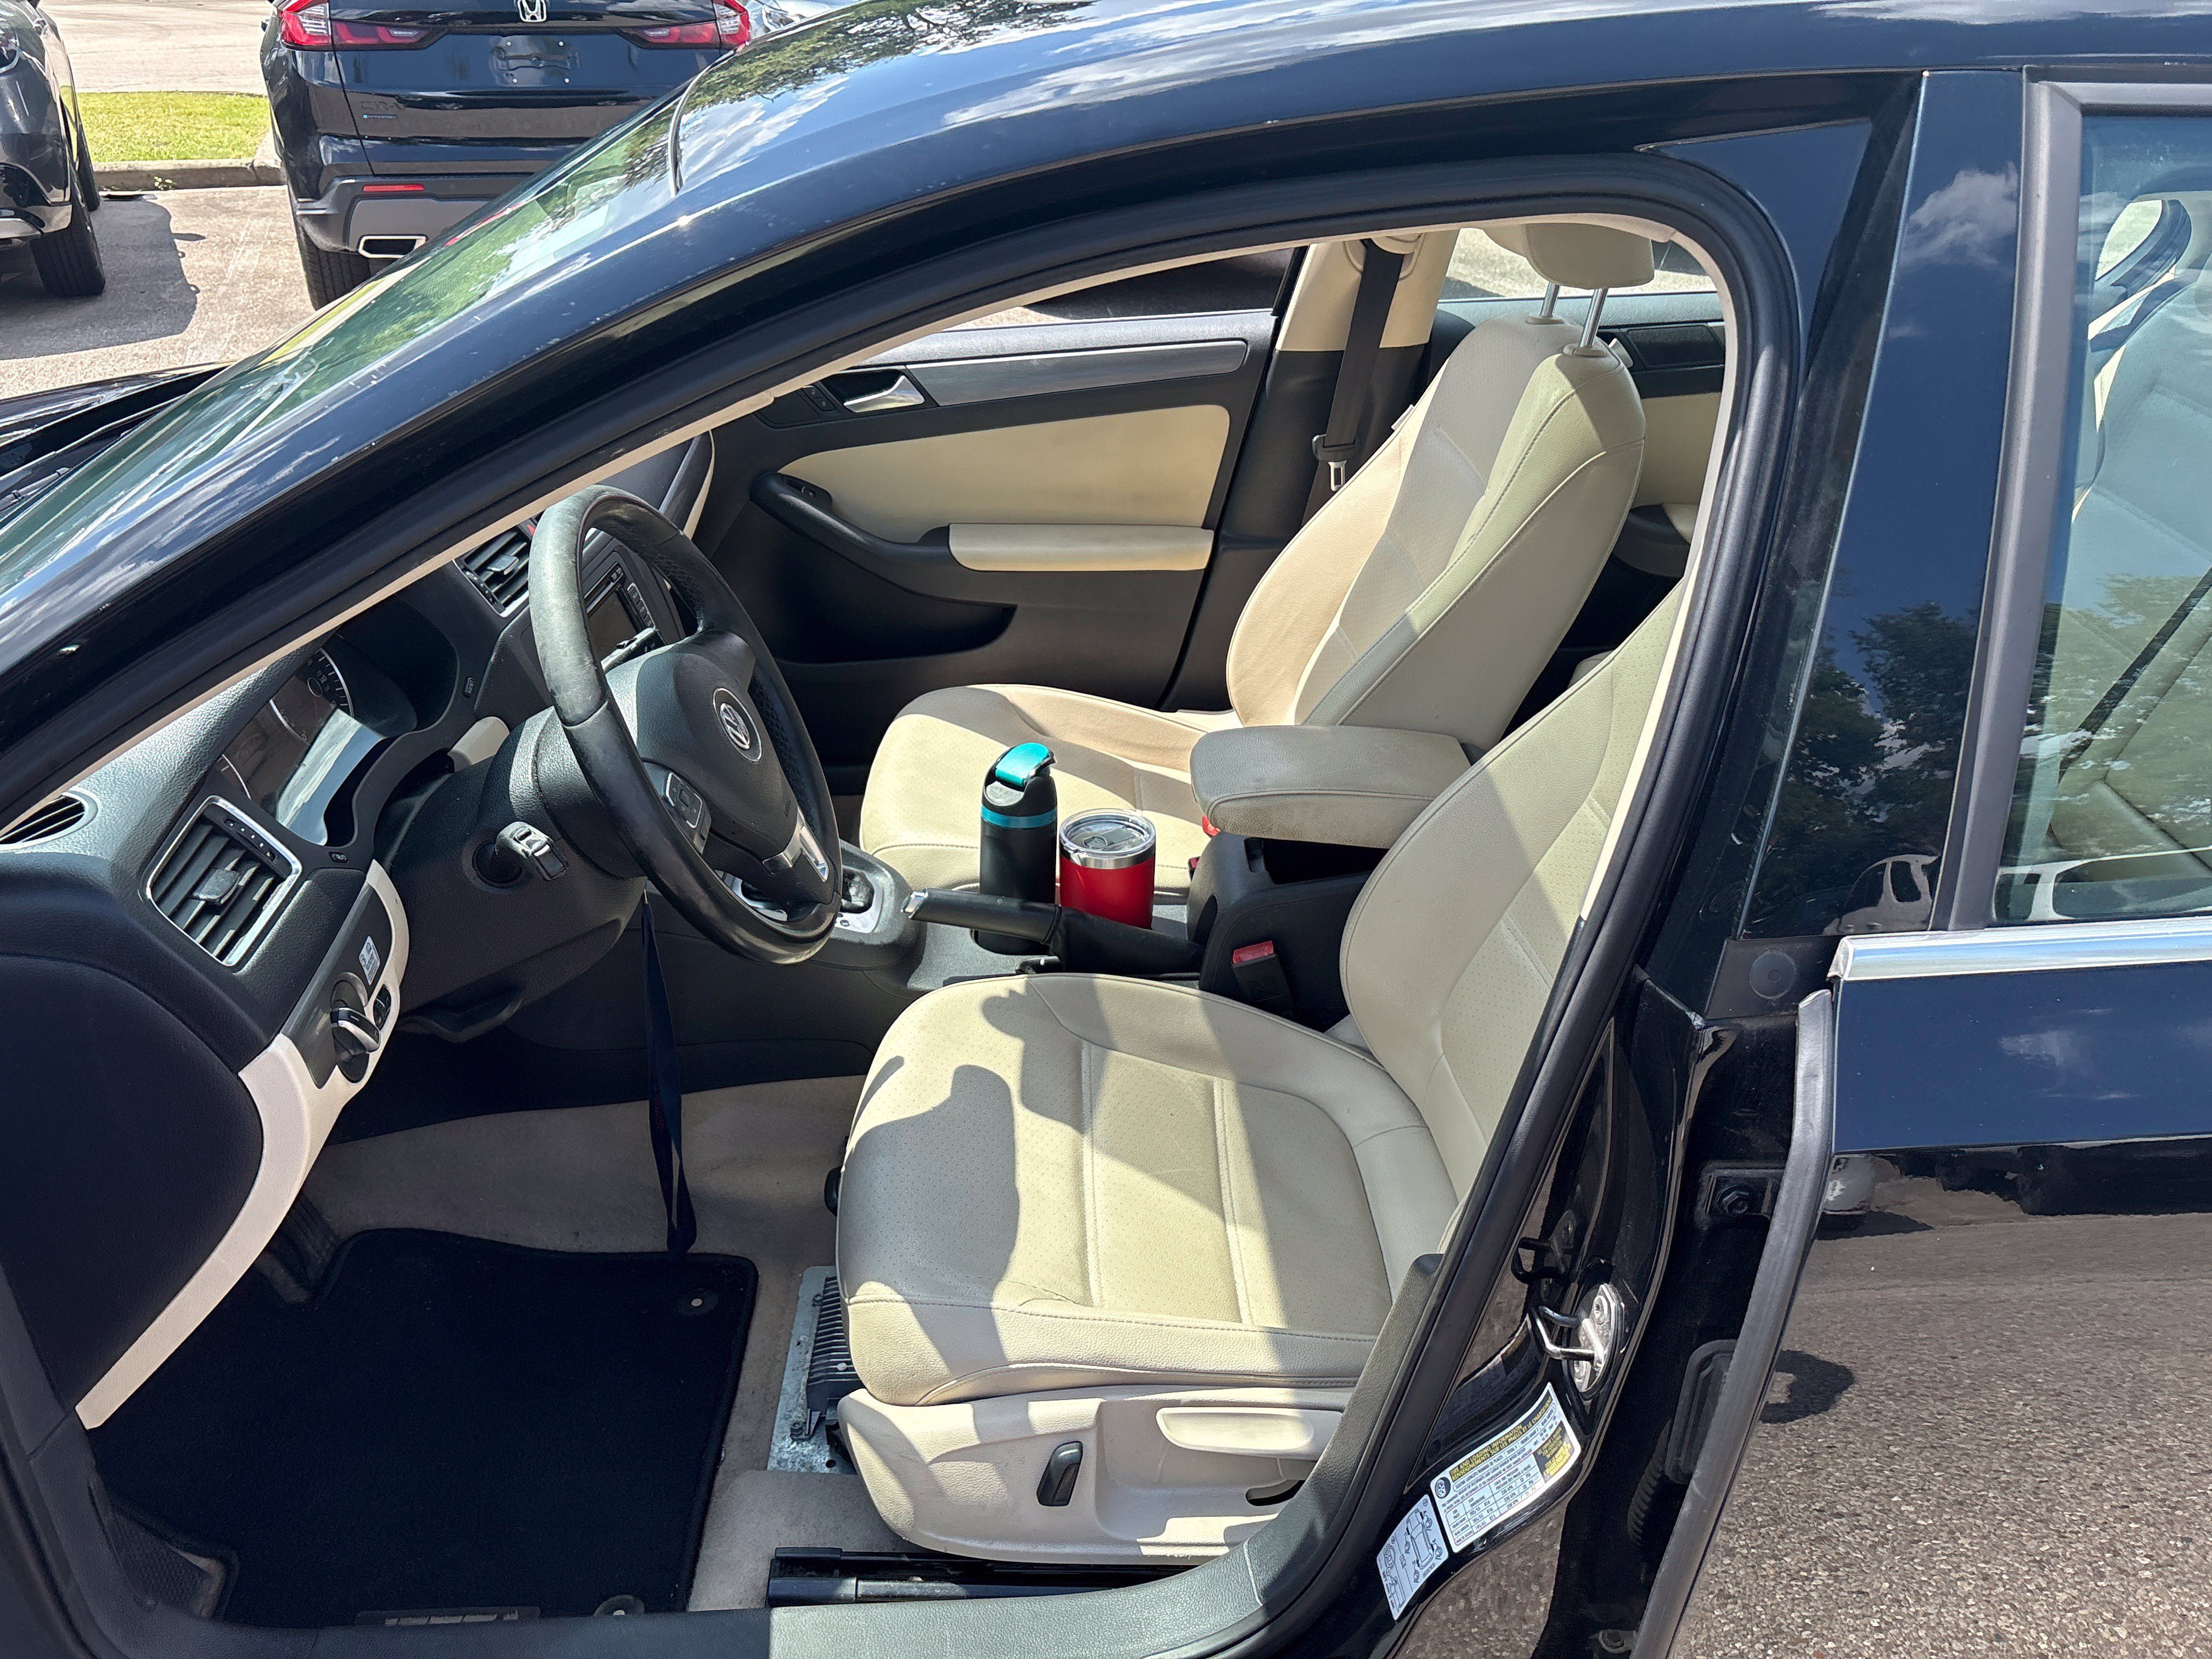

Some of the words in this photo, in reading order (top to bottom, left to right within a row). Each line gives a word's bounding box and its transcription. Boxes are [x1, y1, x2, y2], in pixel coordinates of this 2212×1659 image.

[1459, 1459, 1471, 1469] AND
[1469, 1446, 1491, 1462] LOADING
[1489, 1424, 1523, 1448] INFORMATION
[1490, 1446, 1500, 1455] SUR
[1499, 1441, 1508, 1449] LES
[1507, 1430, 1522, 1443] PNEUS
